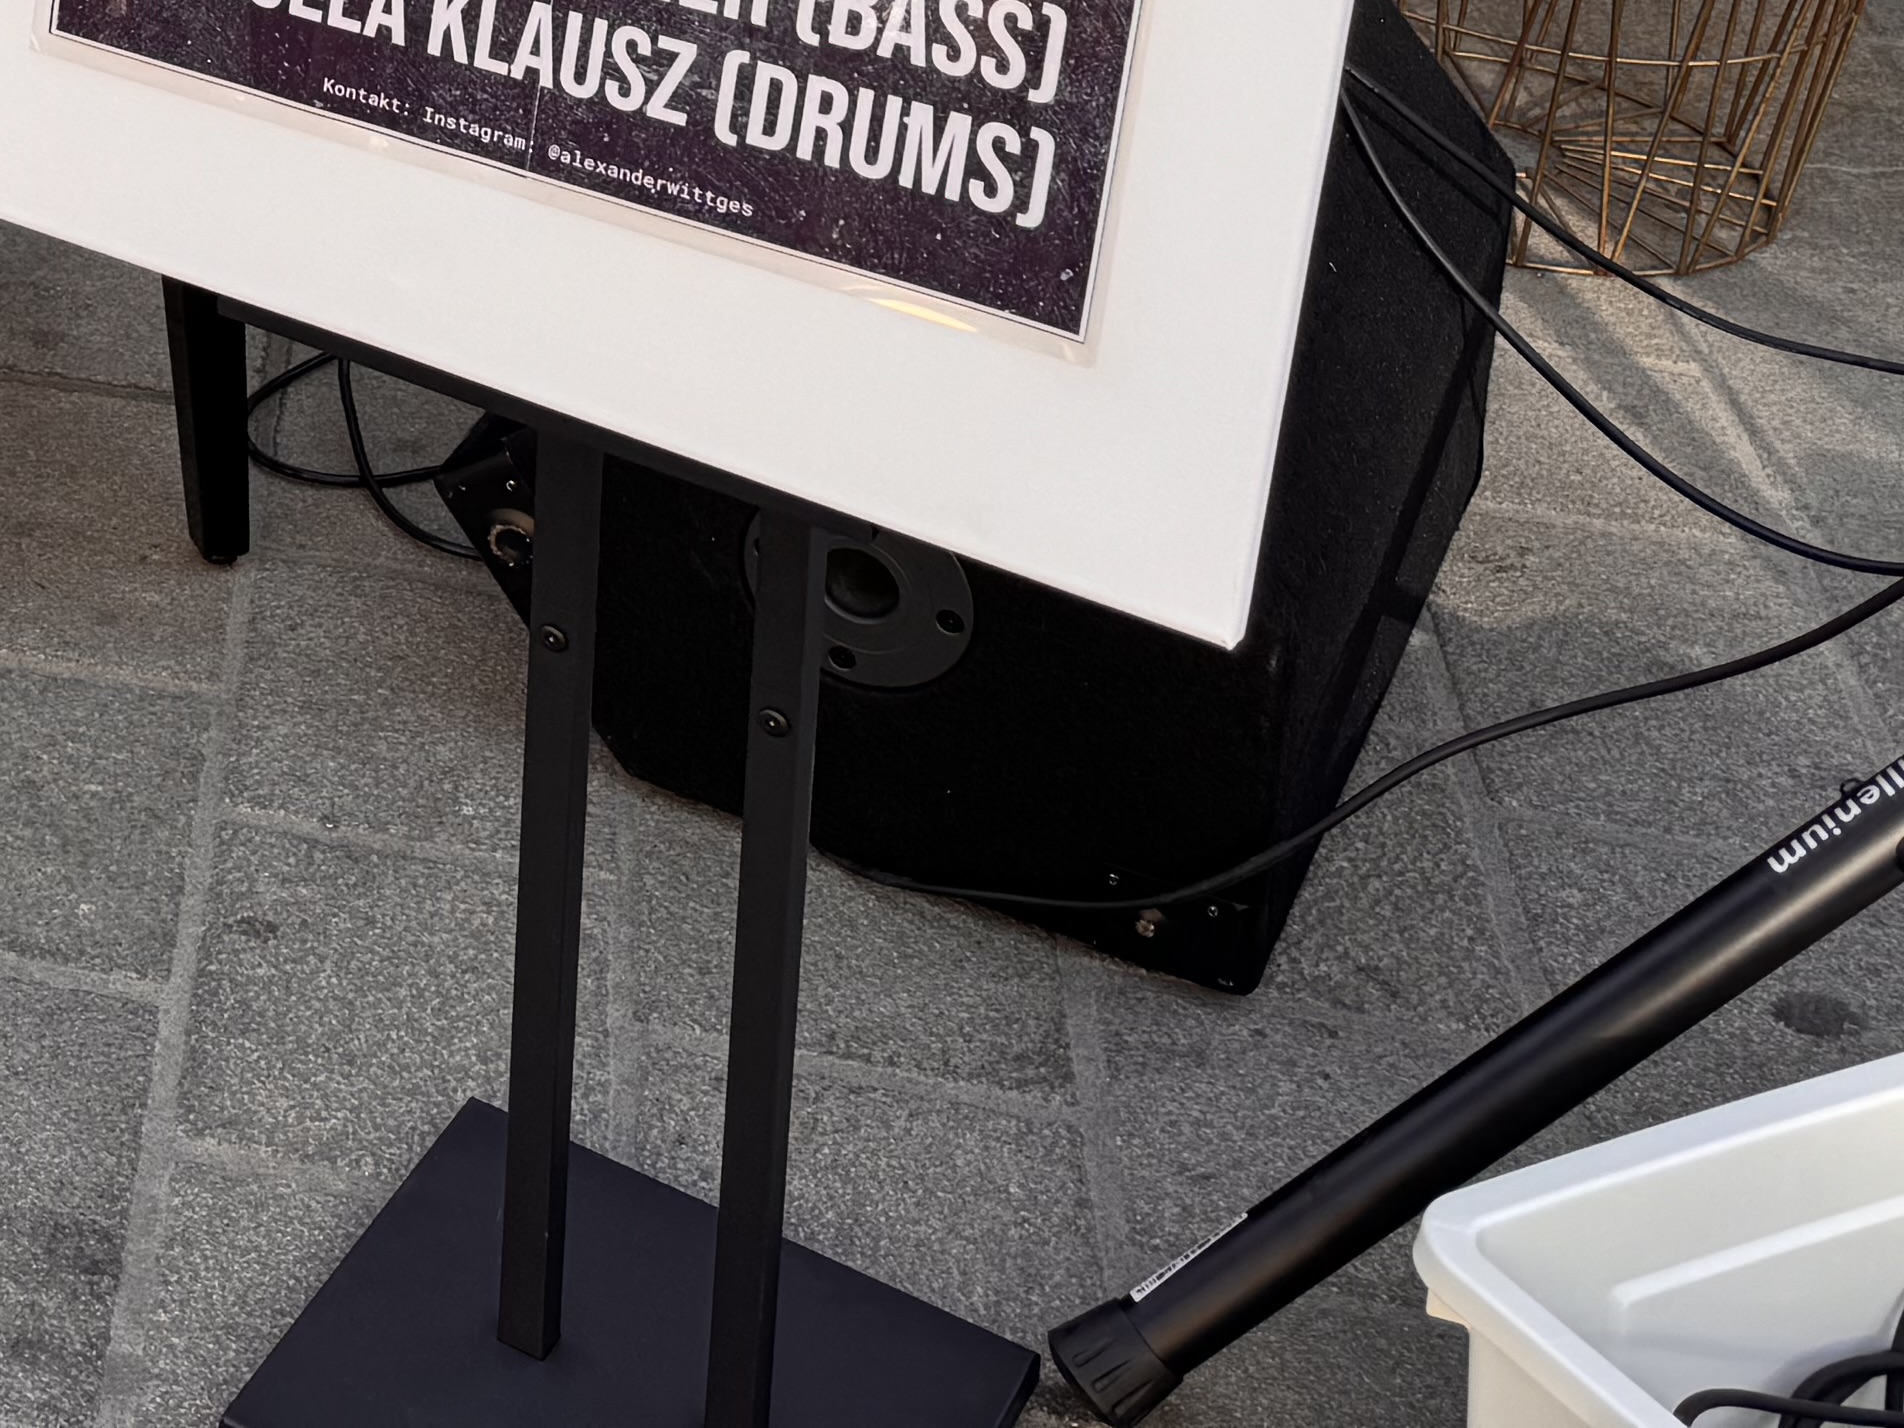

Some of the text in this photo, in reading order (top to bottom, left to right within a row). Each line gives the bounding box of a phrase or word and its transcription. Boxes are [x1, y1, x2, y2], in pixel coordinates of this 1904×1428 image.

[322, 76, 755, 218] Kontakt: Instagram: @alexanderwittges
[713, 48, 1057, 230] (DRUMS)
